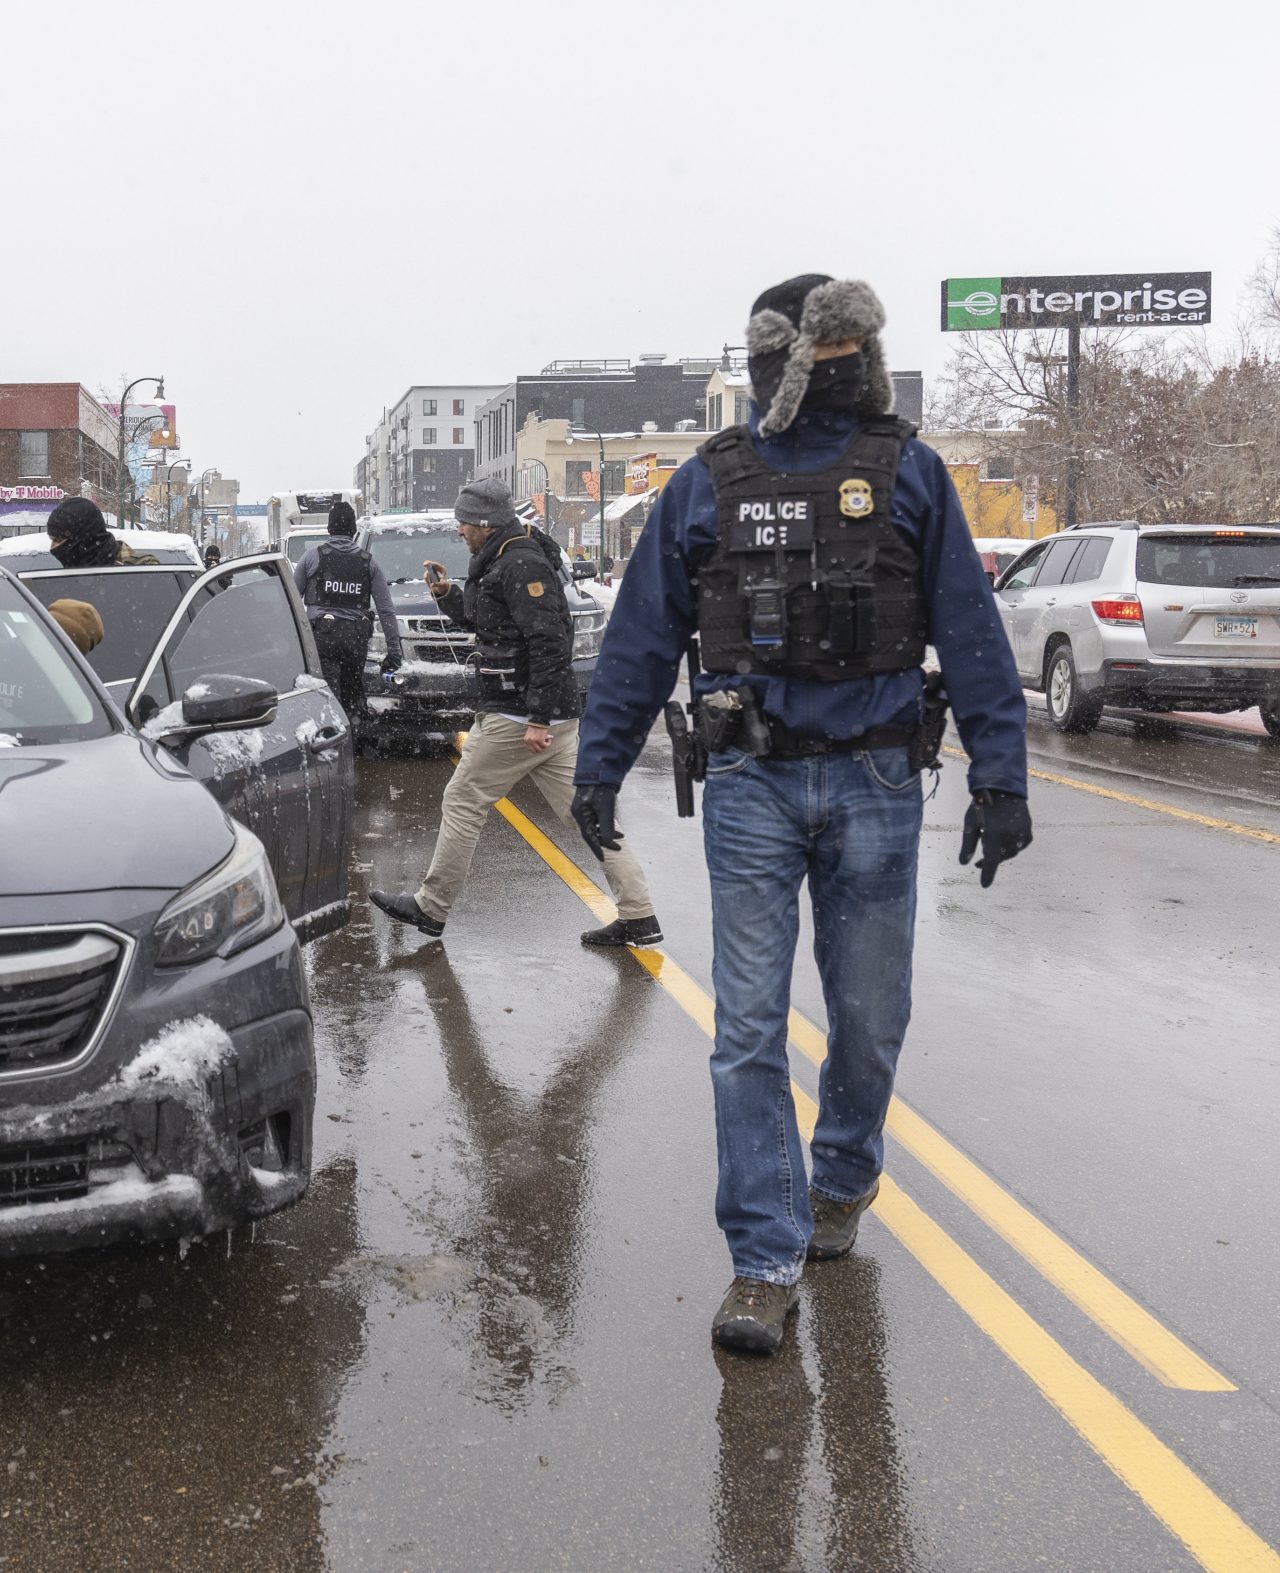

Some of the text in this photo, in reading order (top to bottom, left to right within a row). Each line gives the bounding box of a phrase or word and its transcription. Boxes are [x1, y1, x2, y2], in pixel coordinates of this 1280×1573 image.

[963, 282, 1208, 319] enterprise
[1117, 310, 1207, 322] rent-a-car
[0, 488, 13, 500] by
[27, 487, 63, 499] Mobile
[739, 502, 807, 522] POLICE
[325, 580, 362, 595] POLICE
